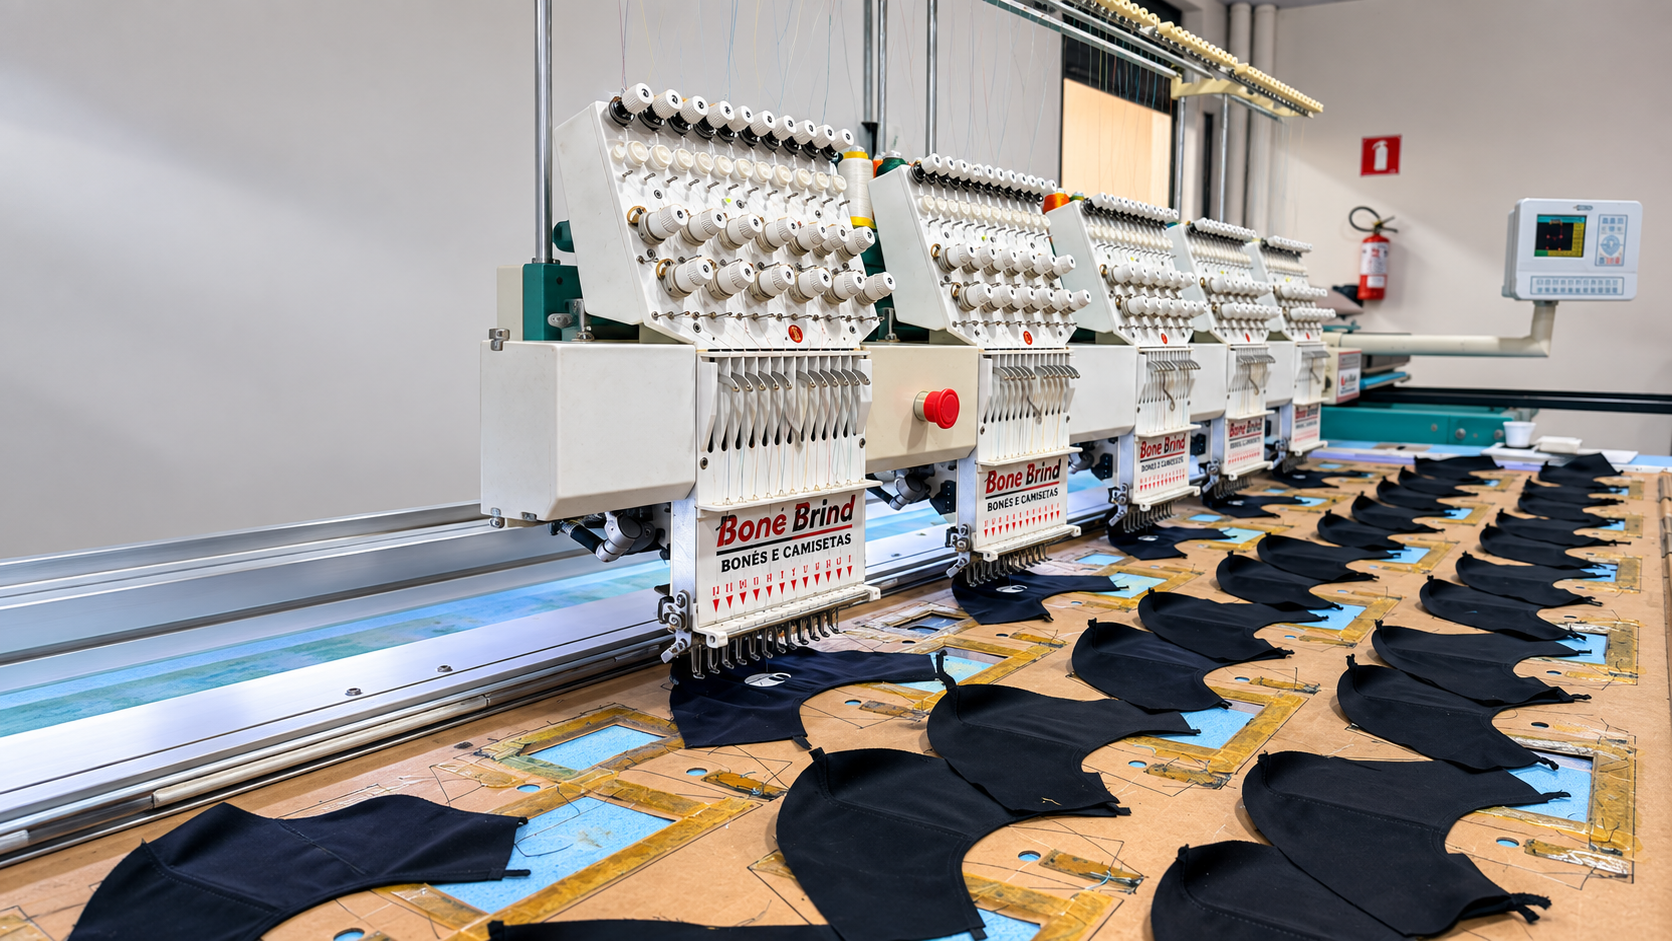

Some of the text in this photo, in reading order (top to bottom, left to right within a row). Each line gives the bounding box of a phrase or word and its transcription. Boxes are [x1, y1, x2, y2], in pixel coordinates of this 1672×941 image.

[1025, 458, 1062, 485] Brind
[1014, 496, 1020, 505] E
[1021, 487, 1059, 504] CAMISETAS
[716, 494, 856, 547] Boné Brind
[721, 550, 768, 573] BONÉS
[772, 549, 779, 562] E
[783, 533, 852, 559] CAMISETAS
